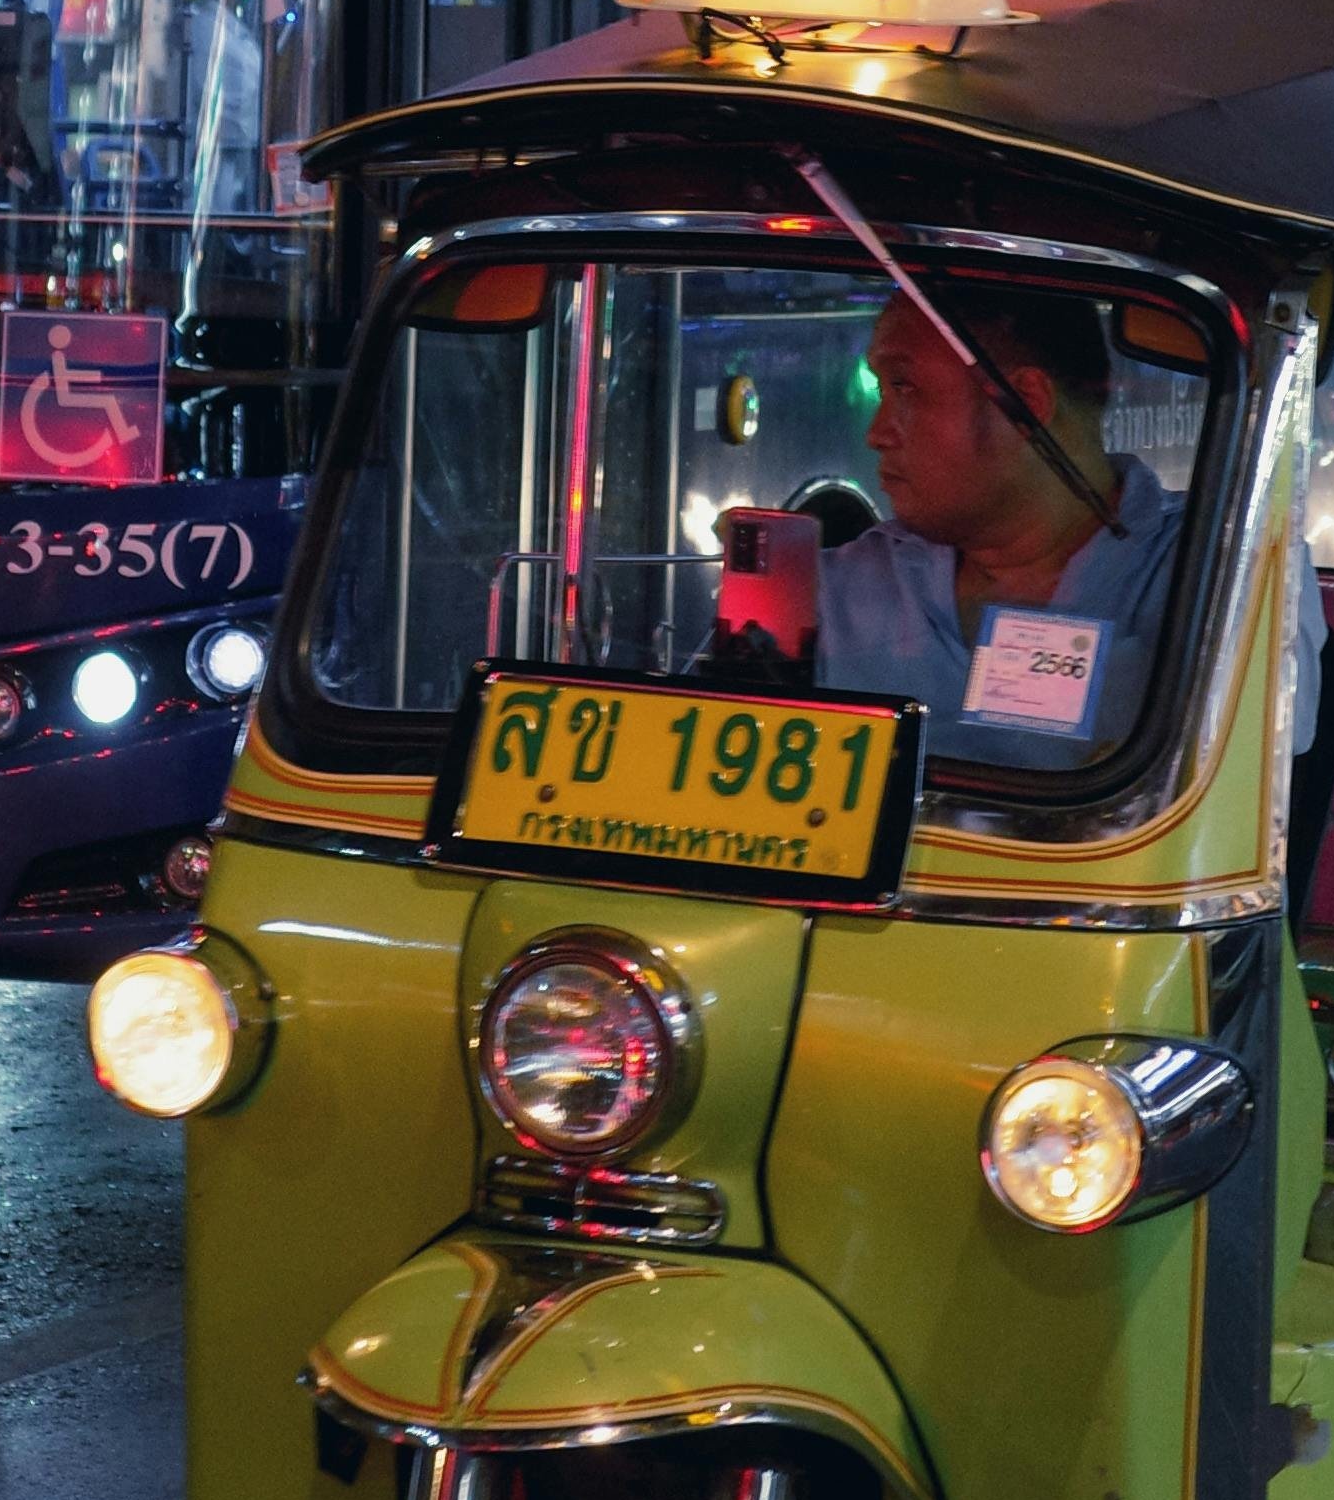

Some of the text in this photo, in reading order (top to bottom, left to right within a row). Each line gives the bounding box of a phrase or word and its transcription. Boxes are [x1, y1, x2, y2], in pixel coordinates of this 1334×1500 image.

[6, 521, 253, 589] 3-35(7)
[1029, 651, 1087, 679] 2566
[671, 707, 874, 811] 1981
